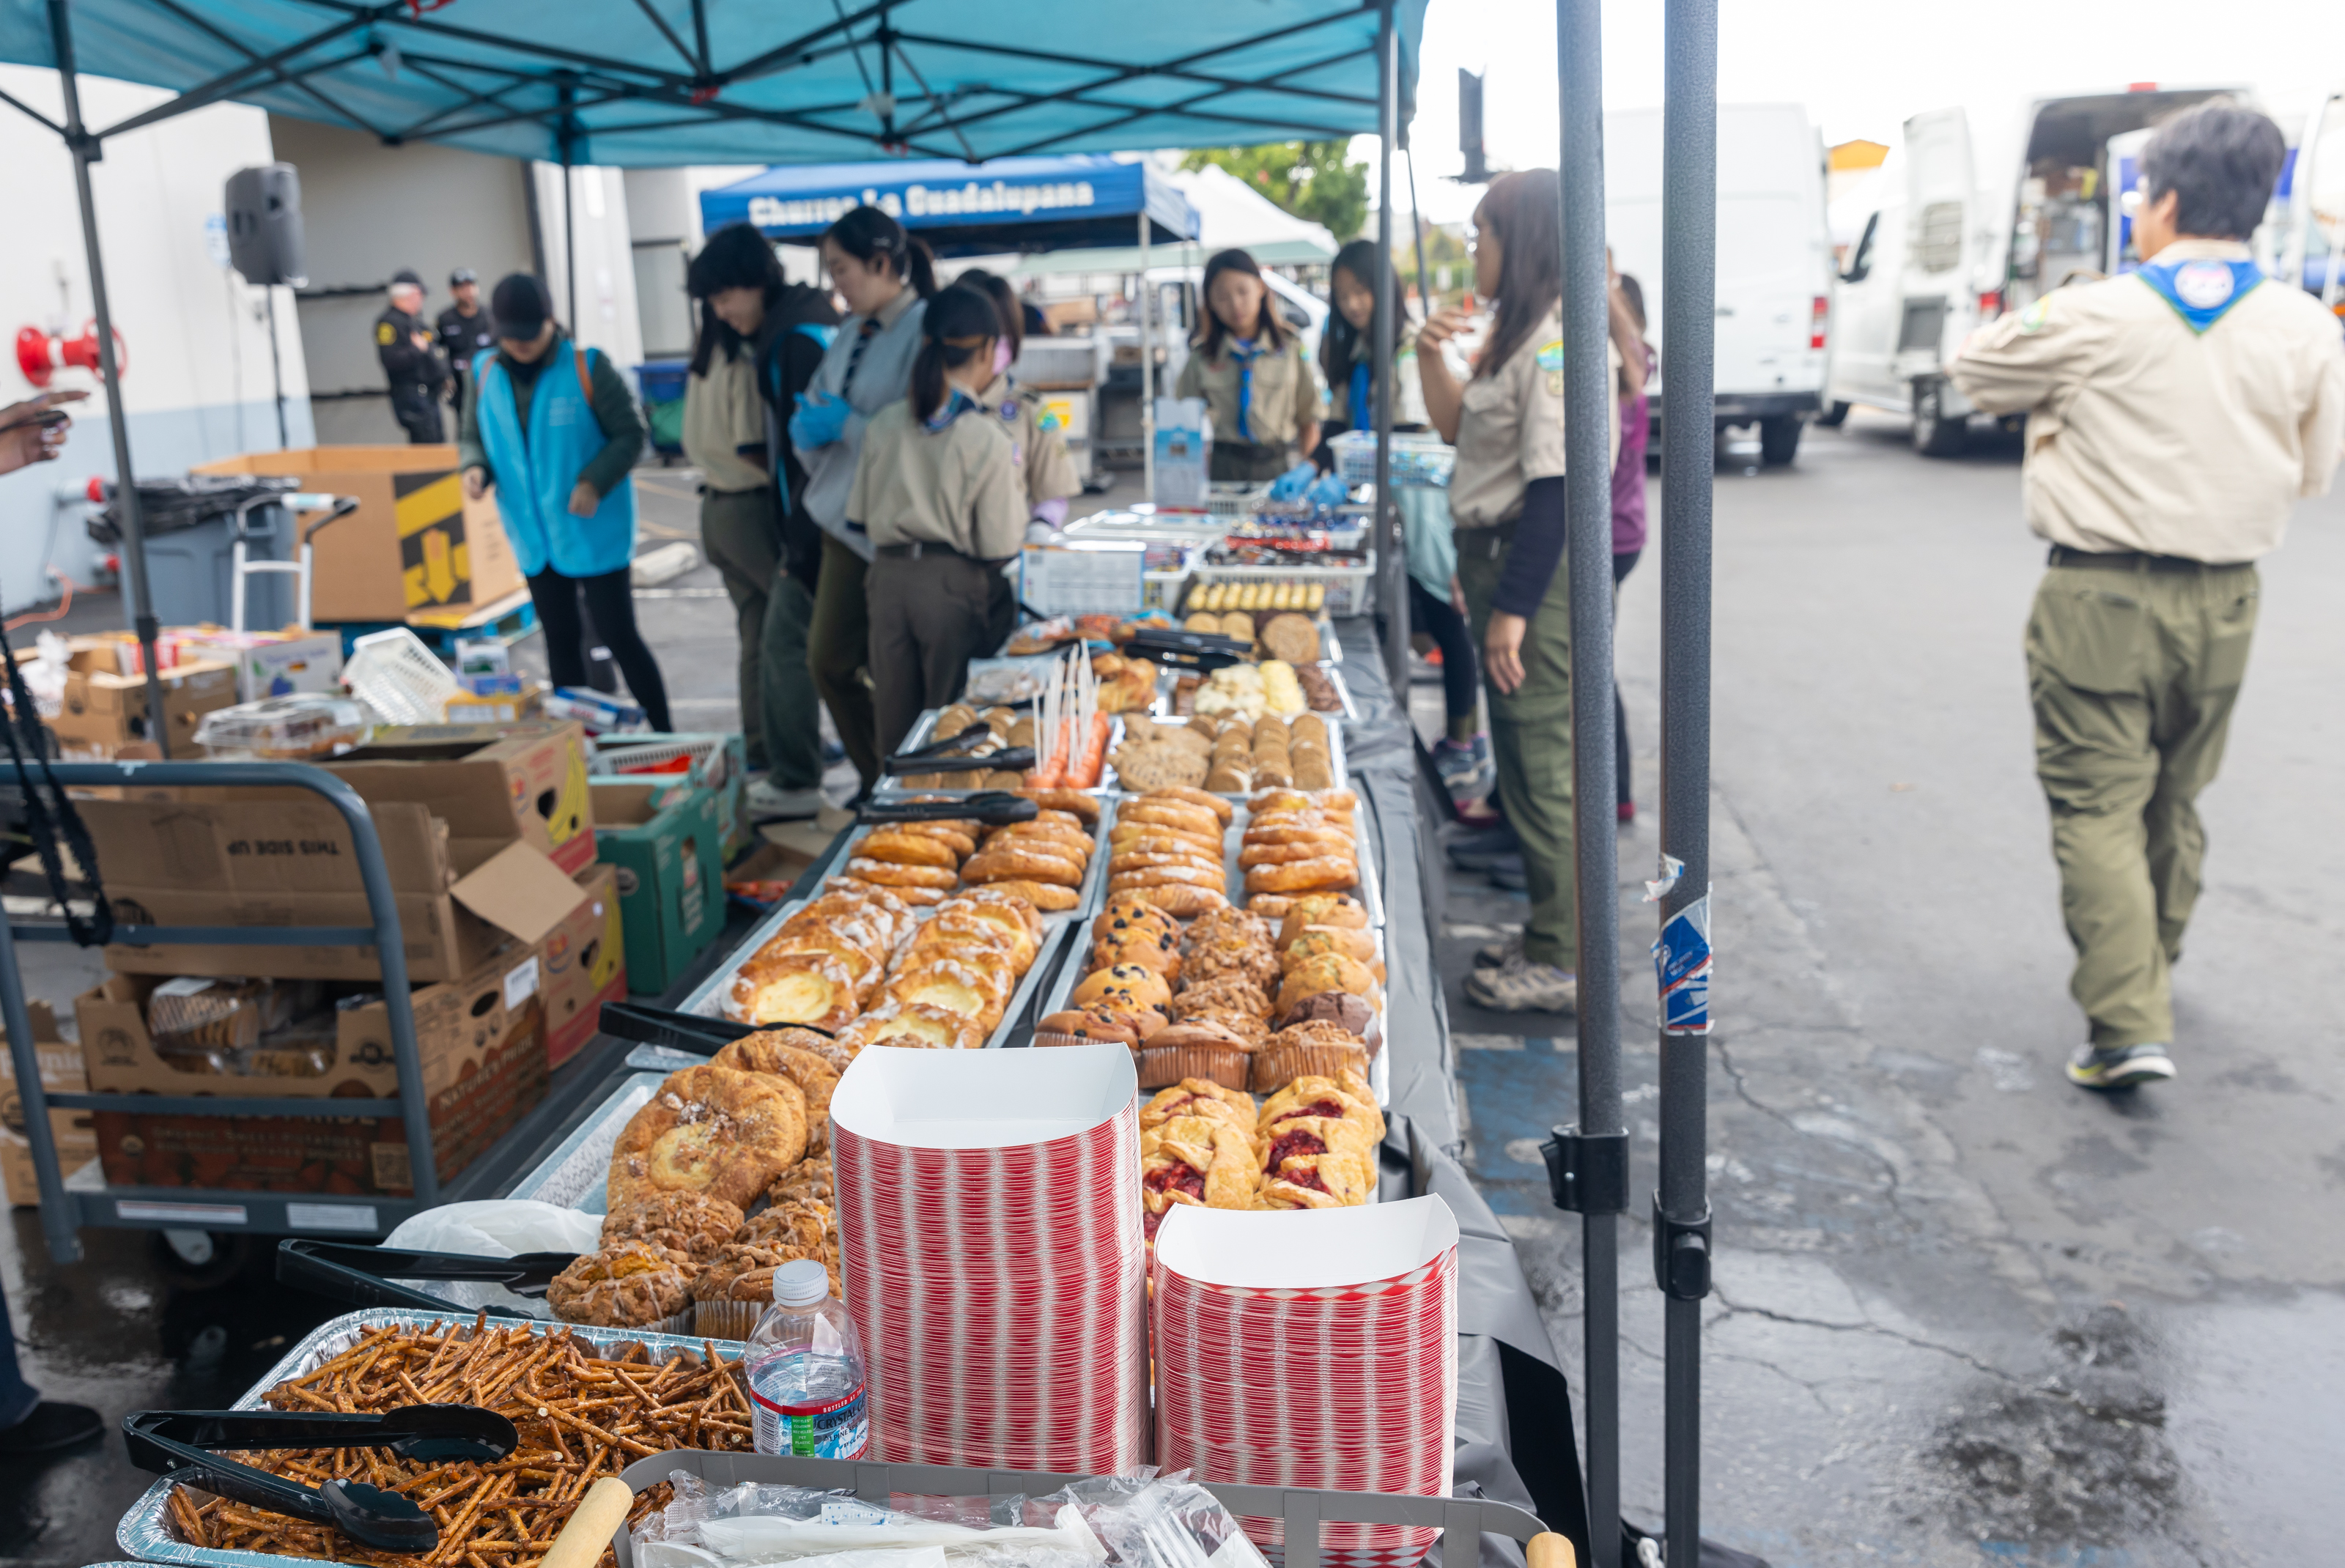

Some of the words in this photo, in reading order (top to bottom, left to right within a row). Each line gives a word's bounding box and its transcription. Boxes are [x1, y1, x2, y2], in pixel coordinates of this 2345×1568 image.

[905, 180, 1095, 218] Guadalupana
[226, 839, 251, 856] UP
[256, 840, 293, 856] SIDE
[299, 840, 339, 856] THIS
[823, 1399, 848, 1413] BOTTLED
[850, 1394, 855, 1402] AT
[817, 1406, 857, 1430] CRYSTAL
[824, 1429, 848, 1443] ALPINE
